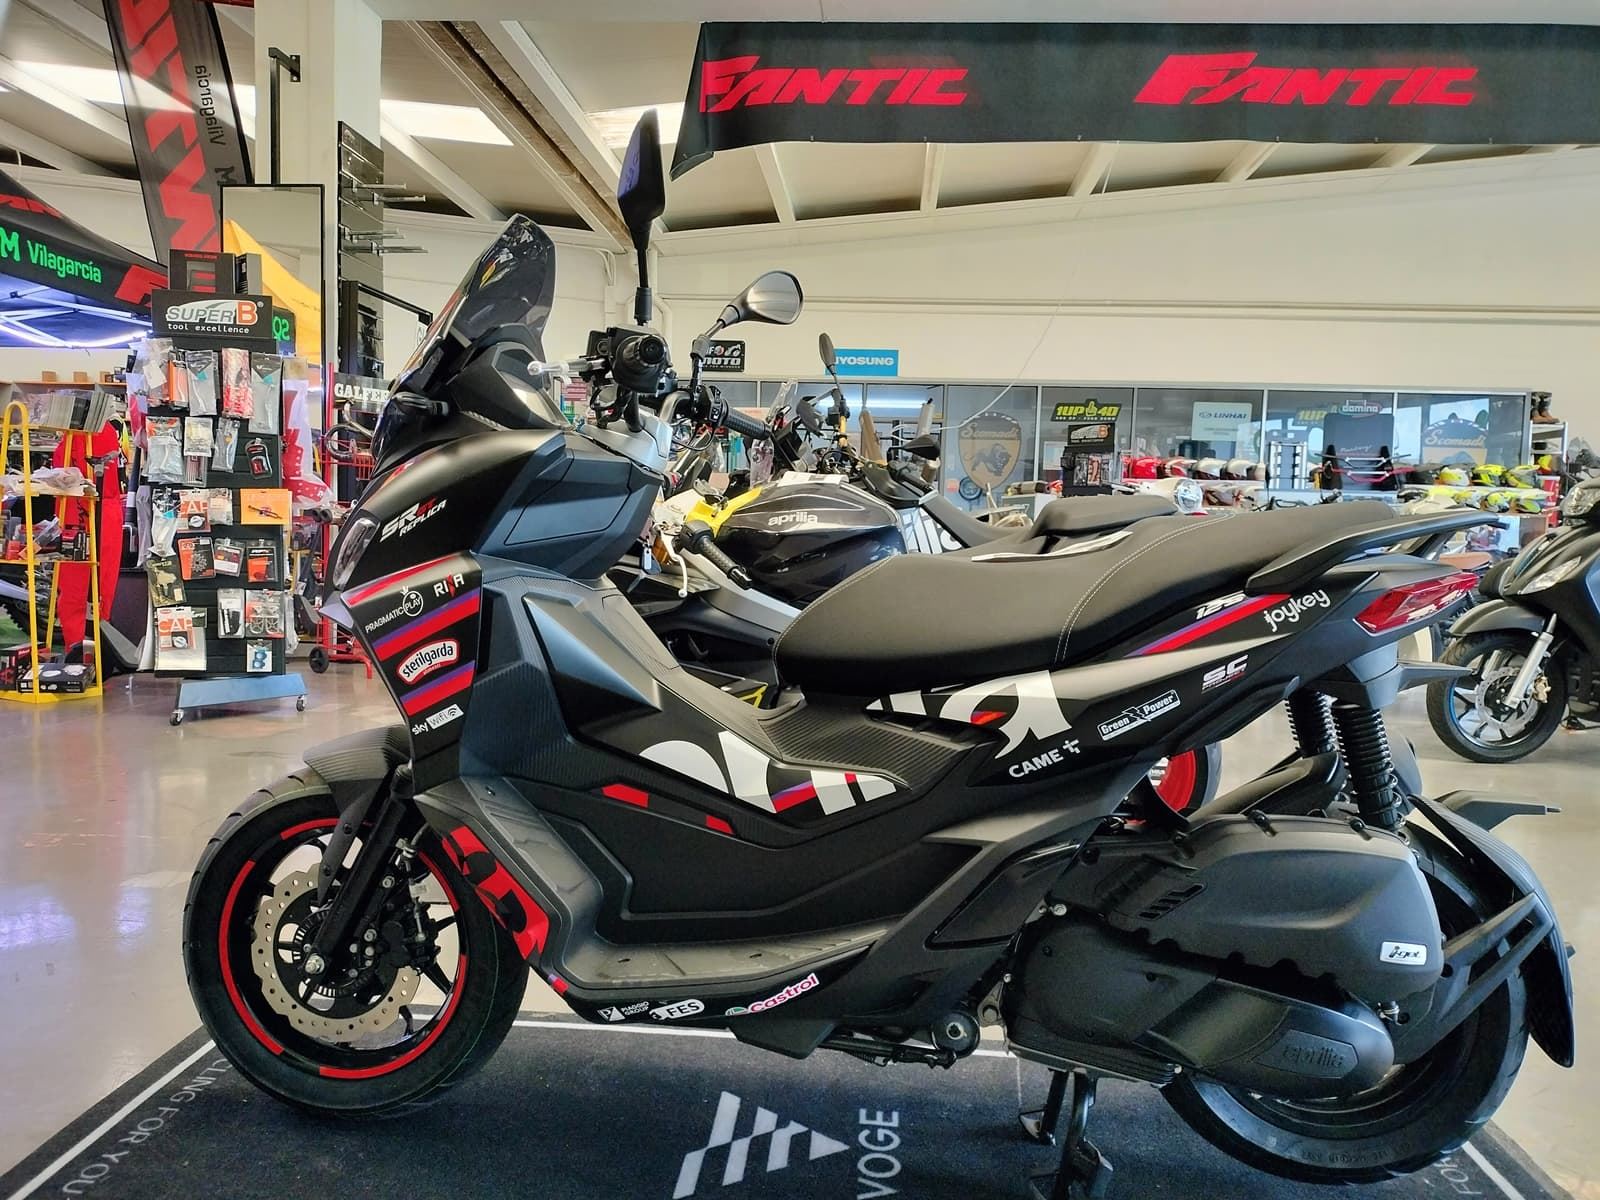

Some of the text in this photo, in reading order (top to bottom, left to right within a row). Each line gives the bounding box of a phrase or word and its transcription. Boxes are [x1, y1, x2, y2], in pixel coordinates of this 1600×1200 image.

[699, 55, 969, 113] FANTIC
[1134, 53, 1479, 105] FANTIC
[26, 239, 102, 284] Vilagarcía
[167, 323, 250, 334] tool excellence
[334, 383, 390, 401] GALFER
[1056, 405, 1085, 417] 1UP
[1213, 411, 1248, 419] LINHAI
[399, 499, 448, 537] REPLICA
[768, 511, 818, 526] aprilia
[364, 597, 422, 634] PRAGMATIC PLAY
[1263, 589, 1331, 632] joykey
[402, 642, 454, 678] sterilgarda
[411, 721, 429, 736] sky
[1100, 694, 1175, 735] Green Power
[1008, 748, 1064, 778] CAME
[666, 1001, 701, 1017] FES
[749, 973, 819, 1012] Castrol
[119, 1106, 180, 1144] FOR
[62, 1150, 130, 1195] YOU
[856, 1108, 901, 1200] VOGE
